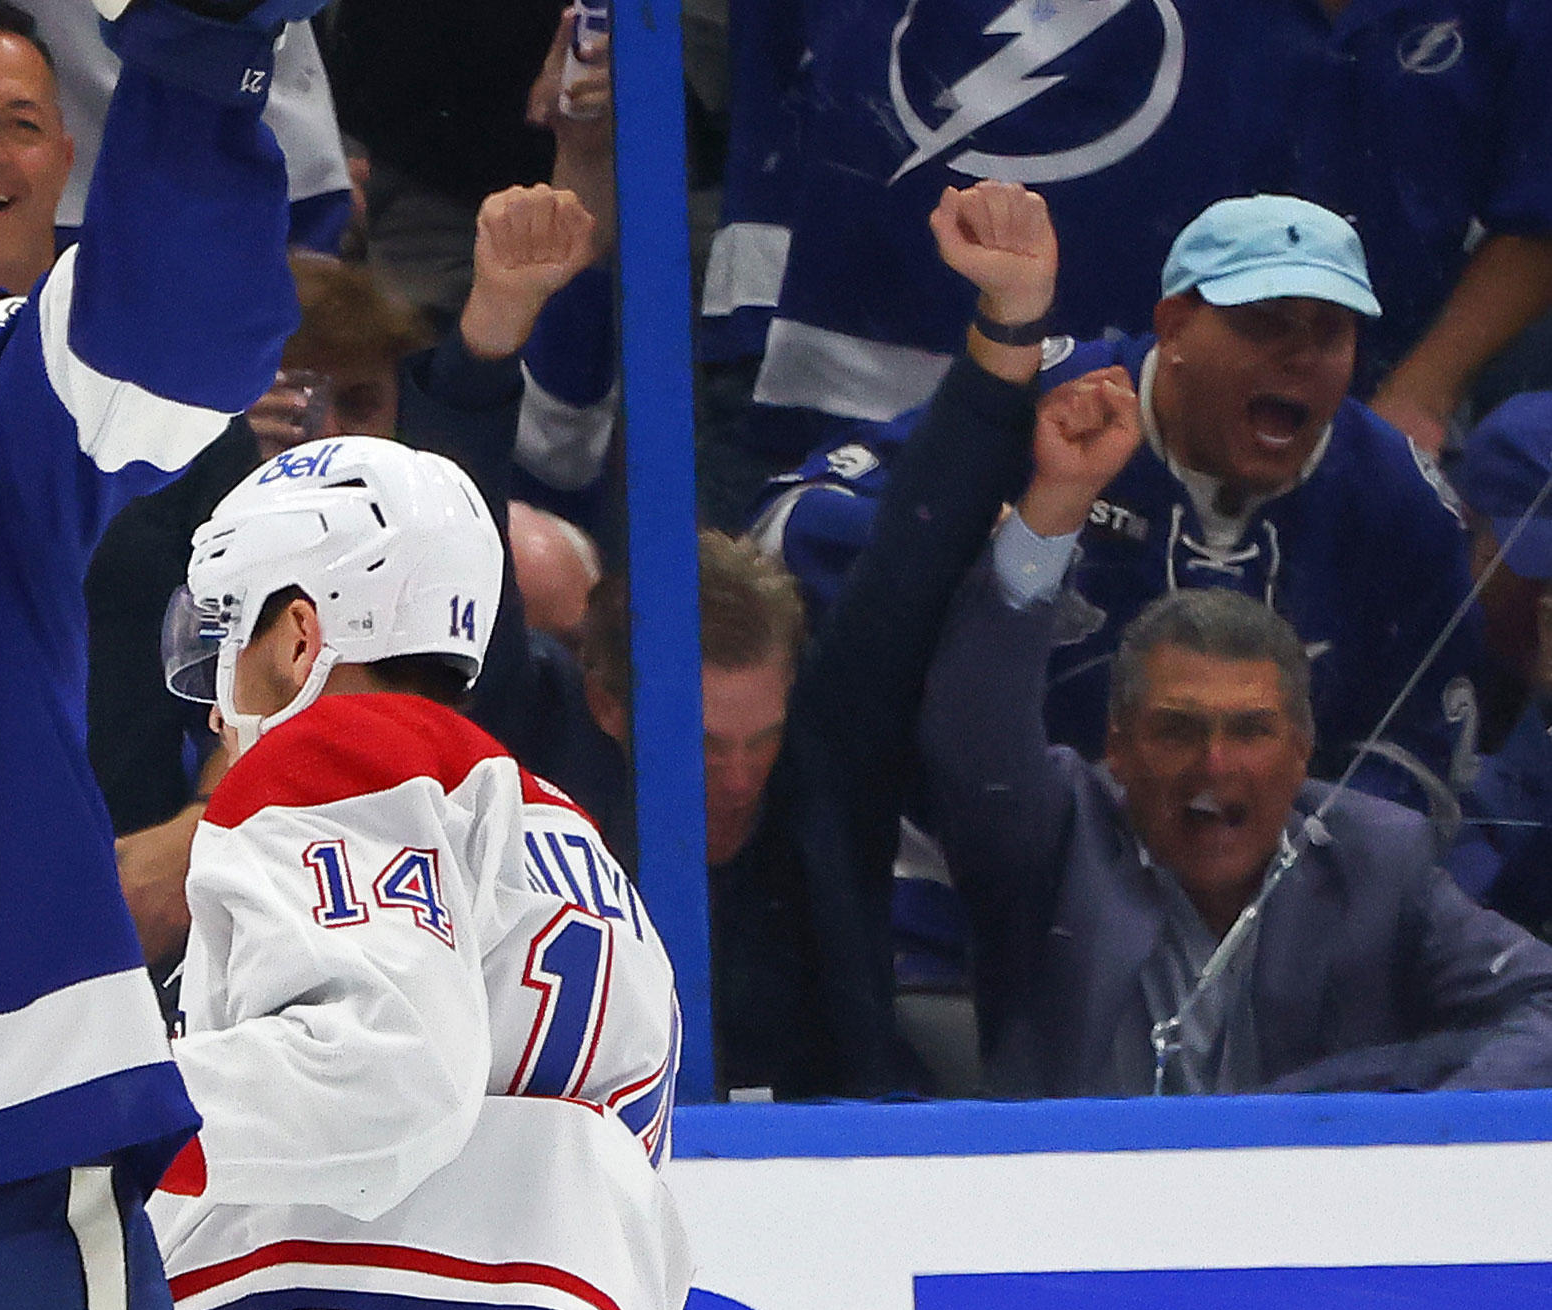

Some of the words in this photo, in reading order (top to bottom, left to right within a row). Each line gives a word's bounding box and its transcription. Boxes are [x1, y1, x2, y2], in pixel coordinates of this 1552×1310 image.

[257, 442, 344, 486] Bell
[449, 594, 476, 642] 14
[301, 838, 456, 949] 14
